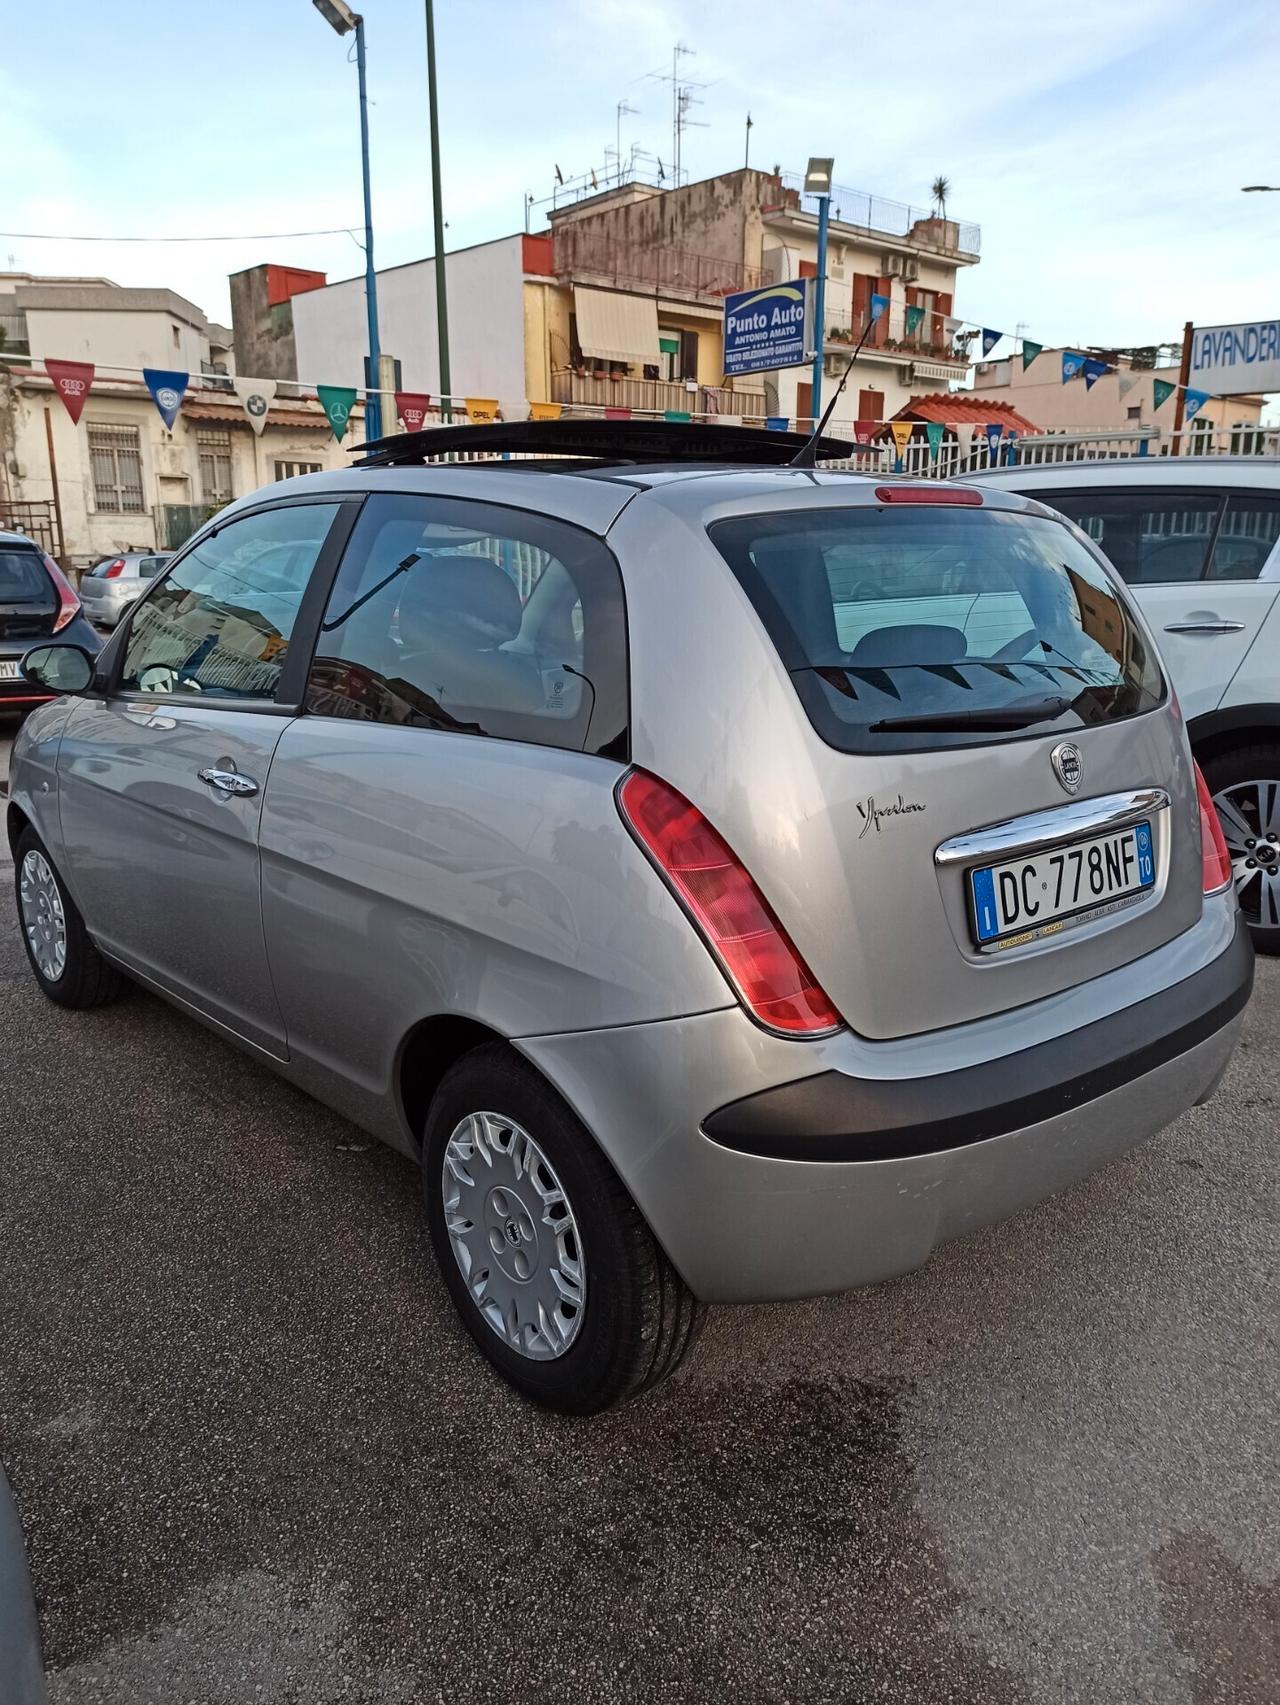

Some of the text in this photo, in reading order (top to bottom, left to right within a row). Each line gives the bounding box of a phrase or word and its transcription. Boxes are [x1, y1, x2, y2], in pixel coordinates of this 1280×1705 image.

[727, 304, 804, 335] Punto Auto
[735, 326, 796, 345] ANTONIO AMATO
[726, 353, 742, 363] USATO
[472, 410, 490, 419] OPEL
[856, 794, 926, 839] Ypsilon
[999, 864, 1040, 926] DC
[1049, 834, 1135, 909] 778NF
[1139, 855, 1151, 878] TO
